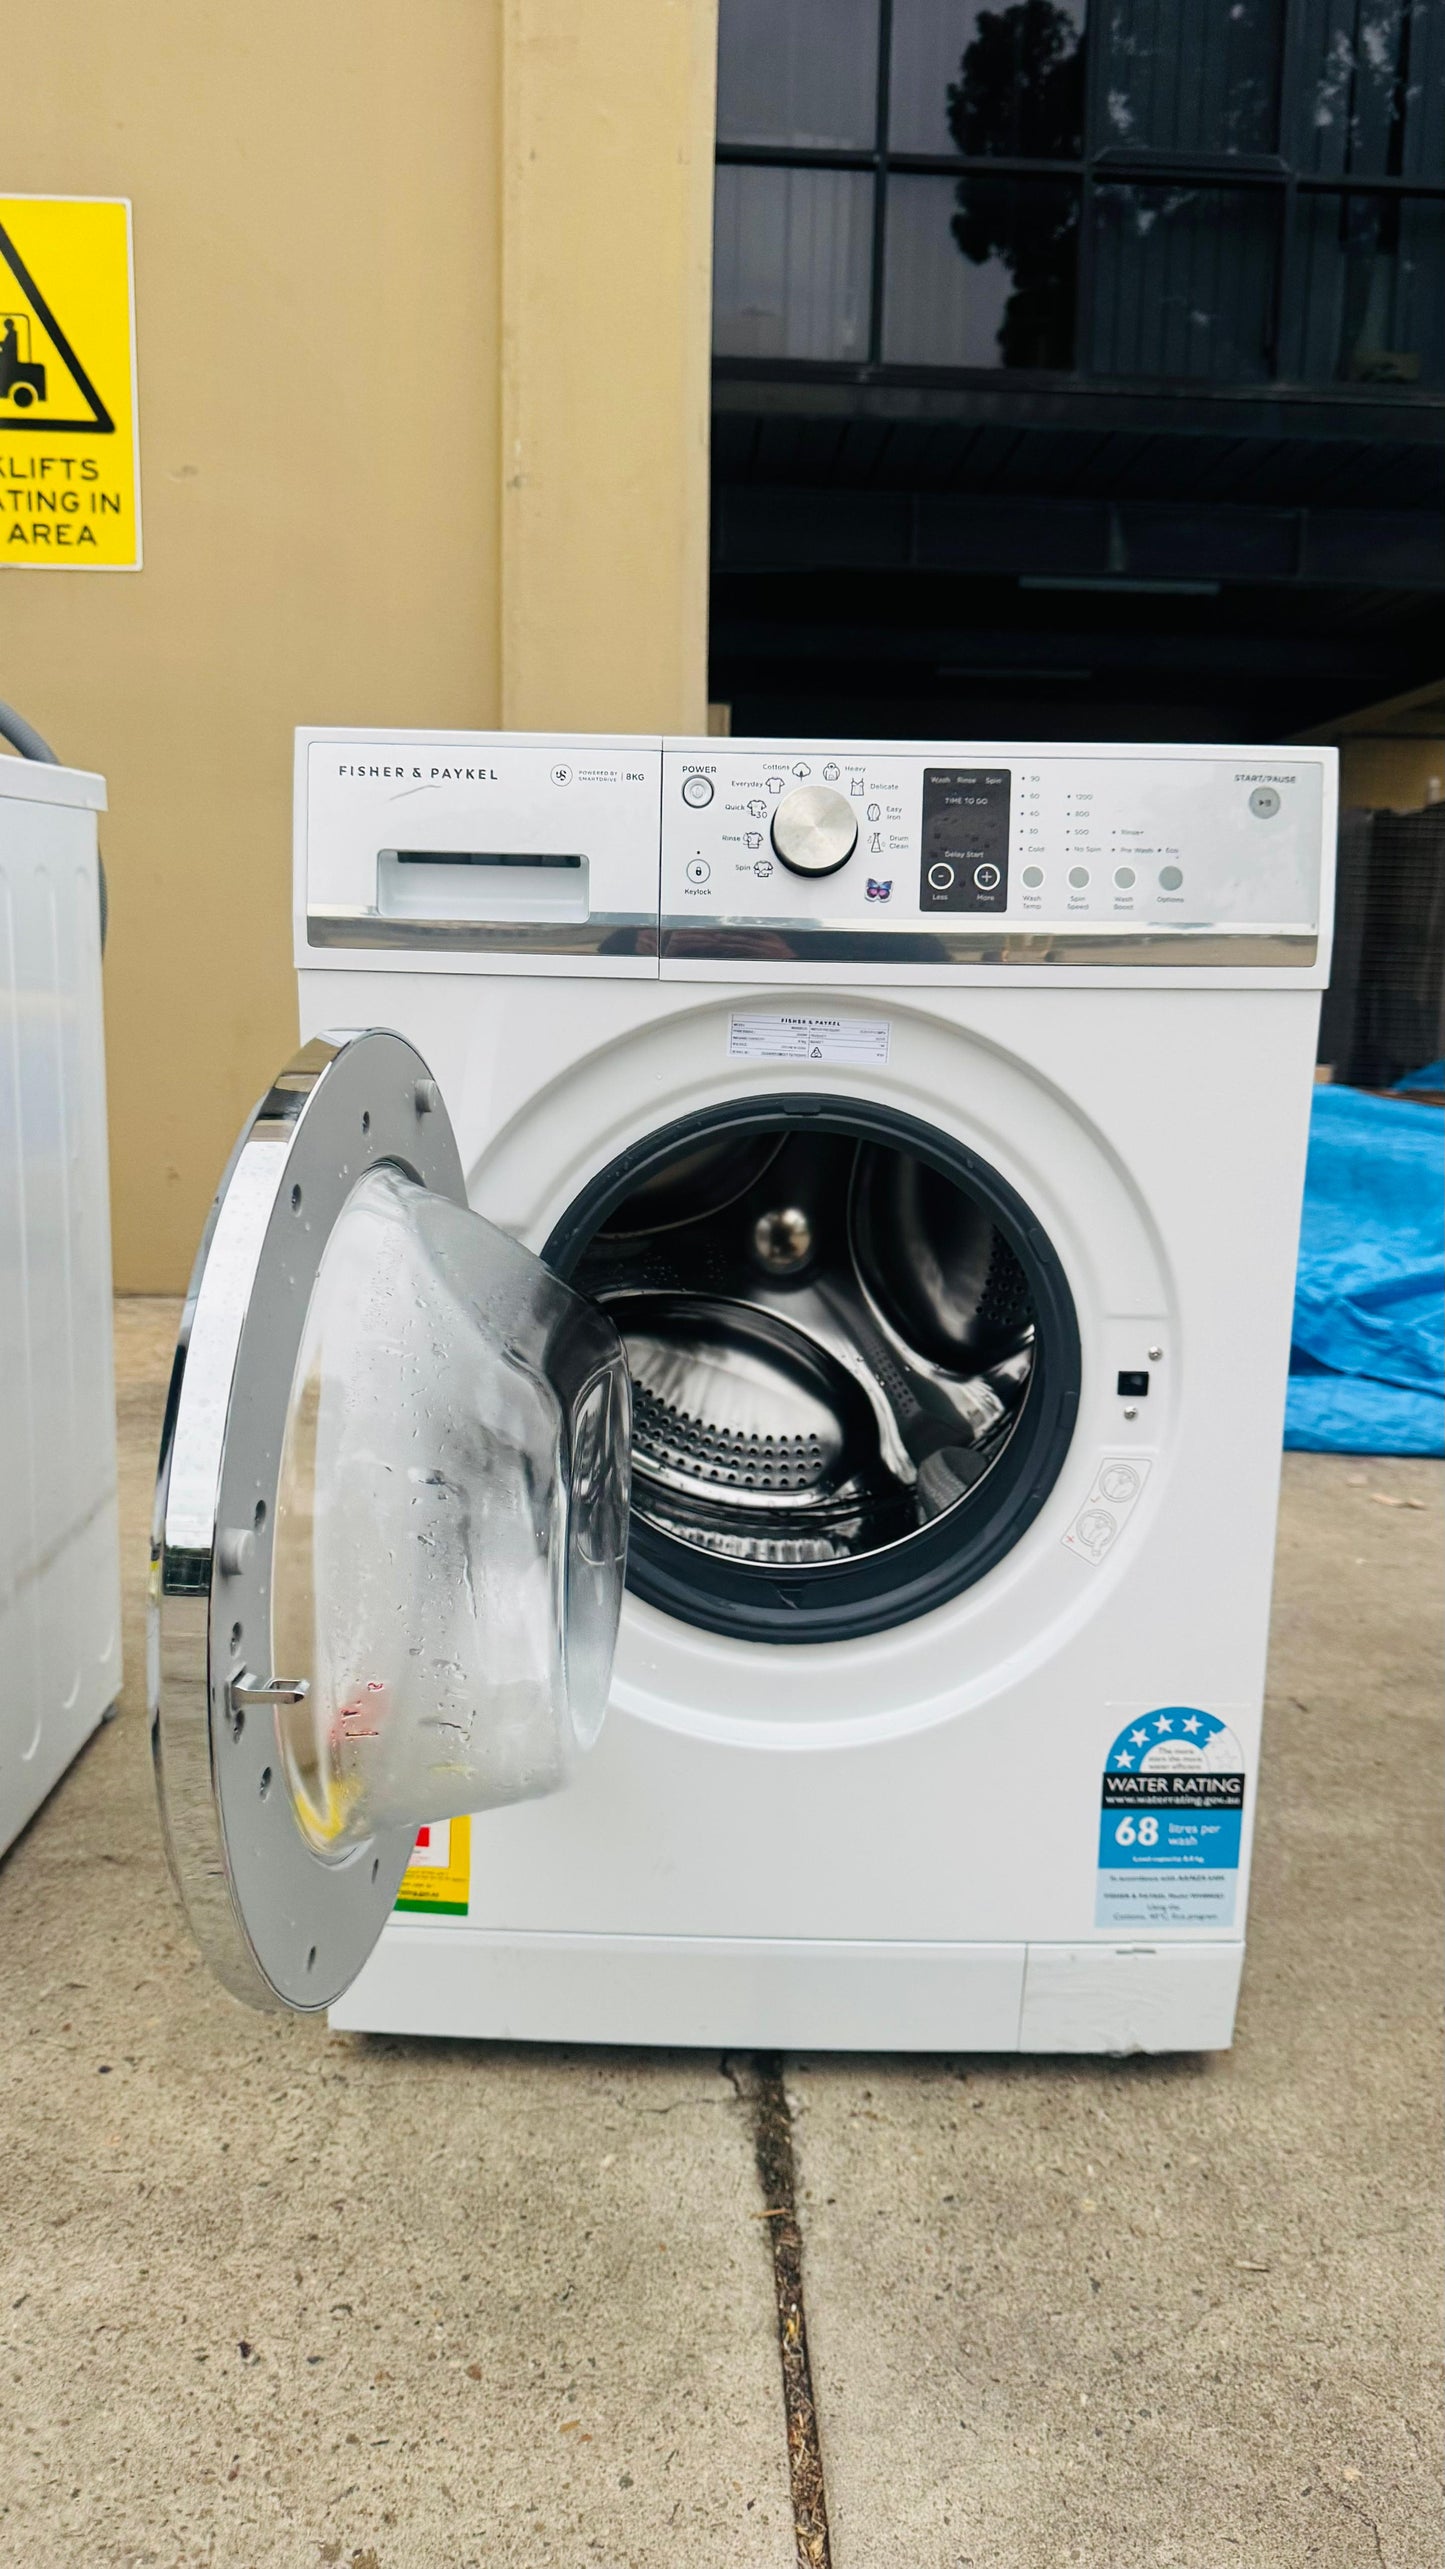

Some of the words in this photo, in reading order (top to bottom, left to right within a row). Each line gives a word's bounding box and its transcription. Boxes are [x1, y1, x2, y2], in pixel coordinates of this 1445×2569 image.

[0, 489, 80, 514] TING
[90, 491, 121, 514] IN
[7, 523, 98, 547] AREA
[681, 765, 717, 774] POWER
[762, 763, 790, 771] Cottons
[338, 765, 405, 778] FISHER
[412, 767, 422, 778] &
[430, 767, 498, 780] PAYKEL
[625, 772, 645, 781] 8KG
[930, 776, 951, 784] Wash
[985, 776, 1002, 785] Spin
[1234, 774, 1296, 784] START/PAUSE
[731, 780, 763, 788] Everyday
[944, 797, 962, 805] TIME
[963, 797, 975, 805] TO
[975, 797, 989, 805] GO
[724, 803, 745, 811] Quick
[755, 811, 768, 819] 30
[721, 834, 741, 842] Rinse
[944, 850, 965, 858] Delay
[735, 864, 751, 872] Spin
[684, 888, 712, 896] Keylock
[932, 893, 949, 901] Less
[1106, 1777, 1169, 1793] WATER
[1172, 1777, 1241, 1793] RATING
[1105, 1793, 1241, 1808] www.waterrating.gov.au
[1114, 1816, 1159, 1846] 68
[1168, 1823, 1198, 1834] litres
[1200, 1825, 1222, 1836] per
[1167, 1835, 1198, 1846] wash
